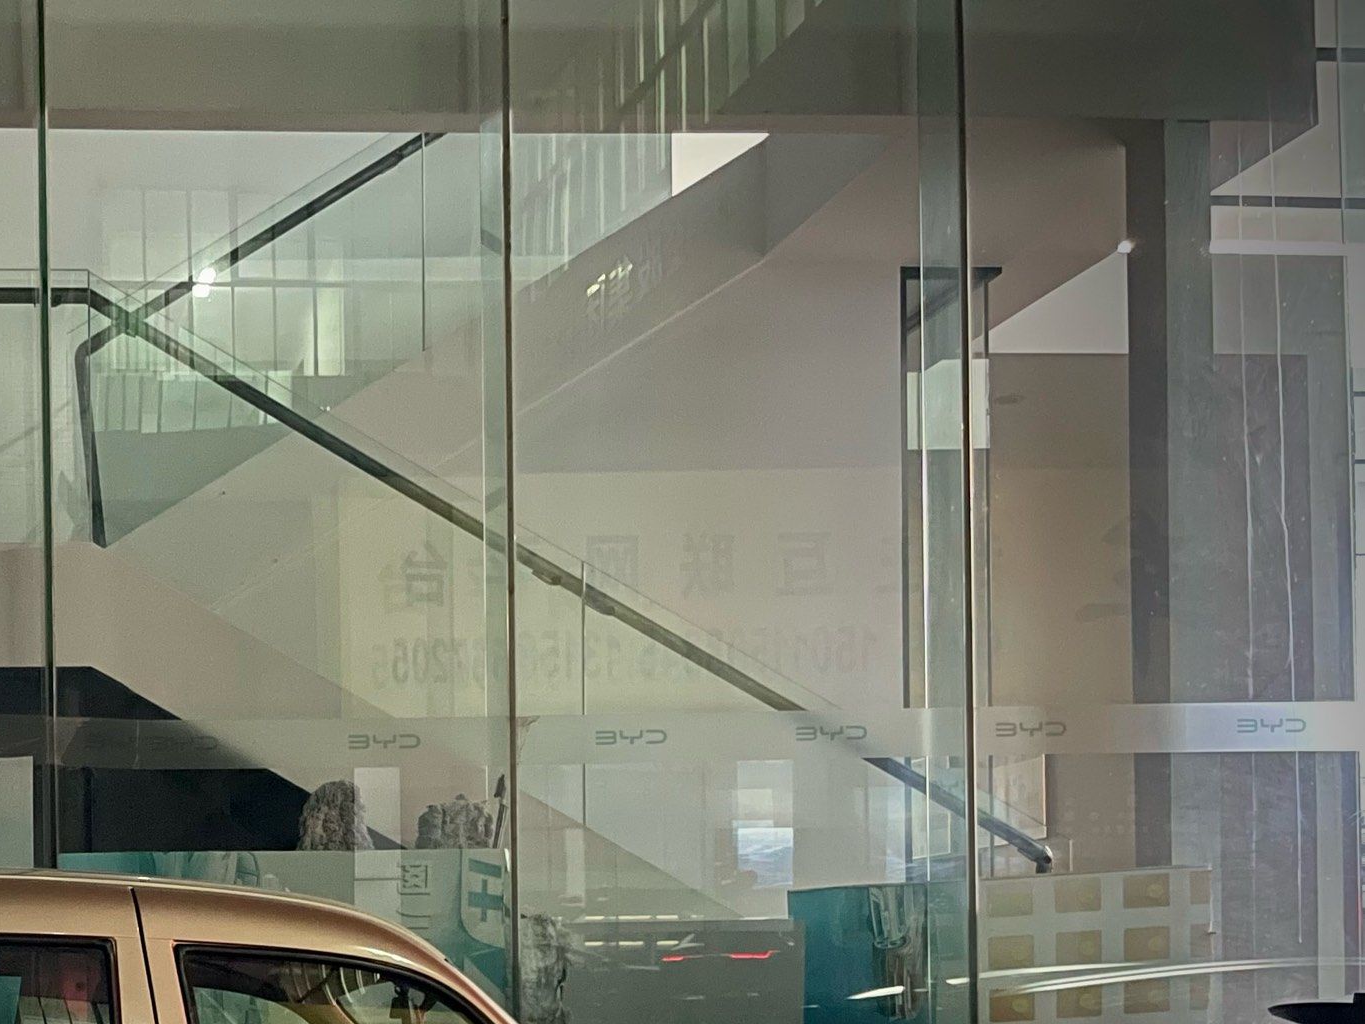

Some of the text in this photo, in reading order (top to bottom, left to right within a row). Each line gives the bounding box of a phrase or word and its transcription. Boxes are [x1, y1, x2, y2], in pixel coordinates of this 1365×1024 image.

[795, 724, 868, 741] BYD
[996, 721, 1067, 738] BYD
[1238, 718, 1307, 733] BYD
[348, 732, 422, 749] BYD
[595, 729, 668, 745] BYD
